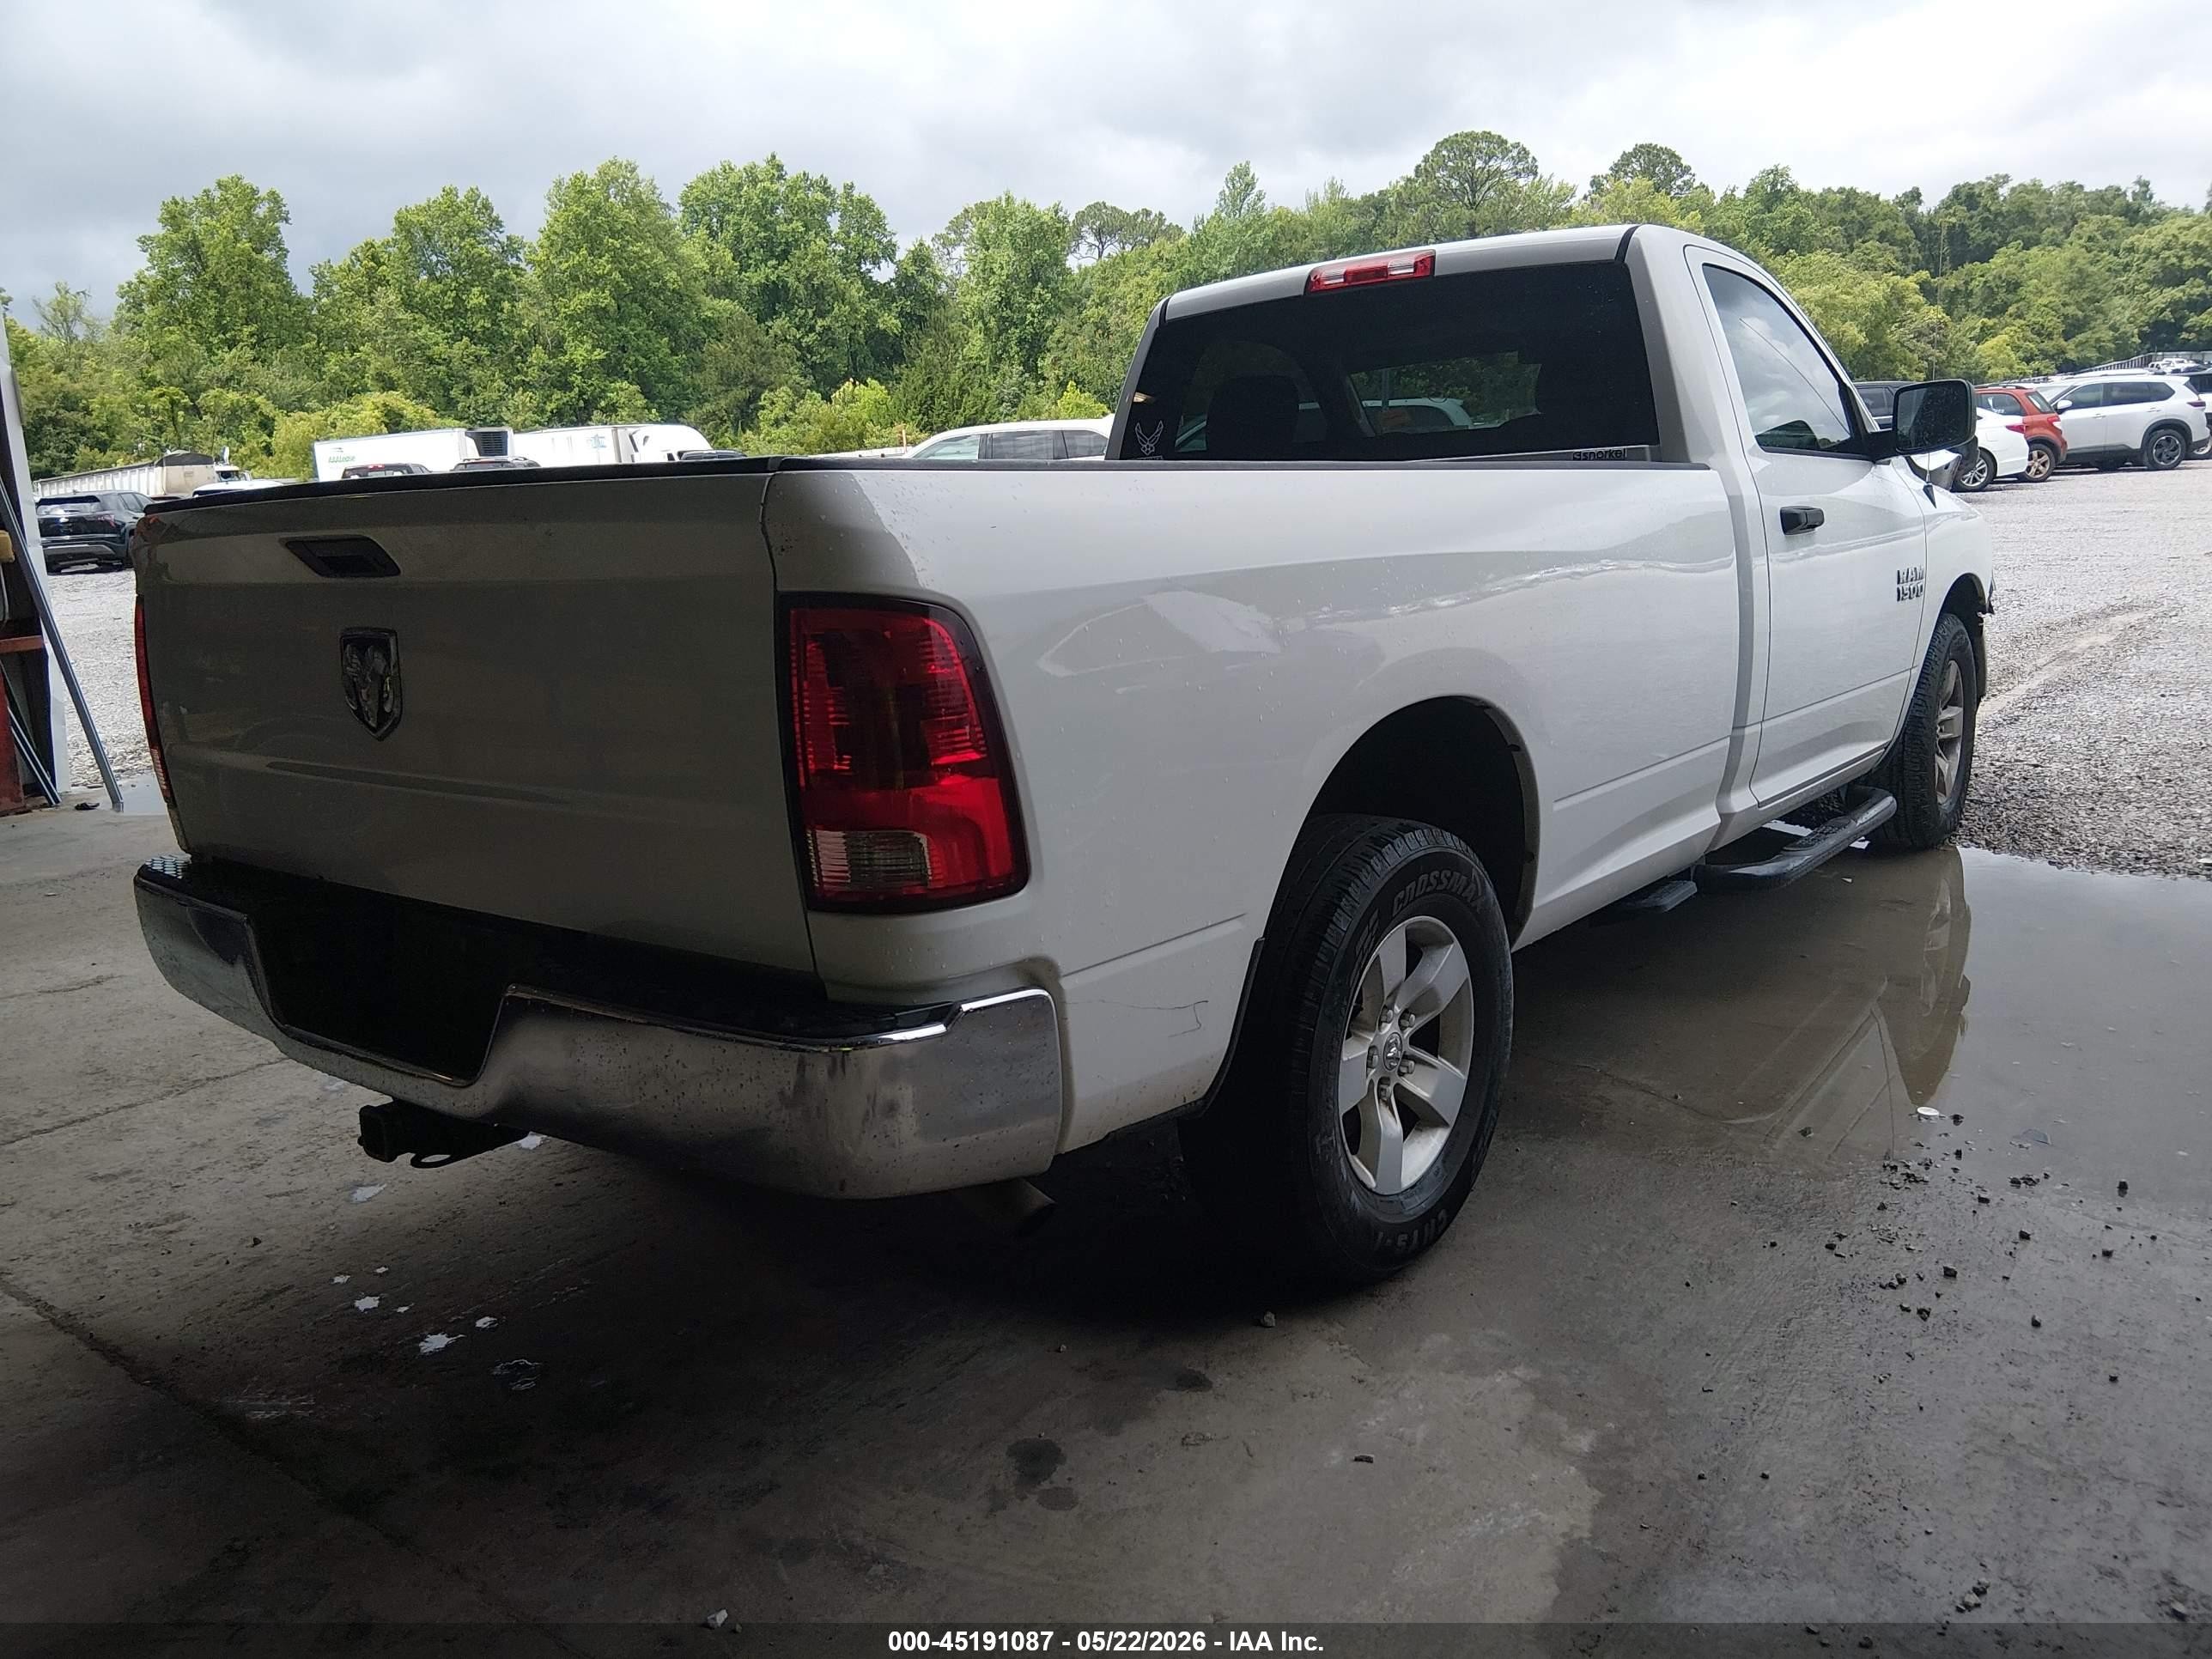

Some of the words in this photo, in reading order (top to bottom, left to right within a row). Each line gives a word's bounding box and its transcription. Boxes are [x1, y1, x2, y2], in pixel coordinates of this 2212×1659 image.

[1582, 448, 1627, 461] snorkel
[1897, 566, 1924, 585] RAM
[1897, 582, 1923, 602] 1500
